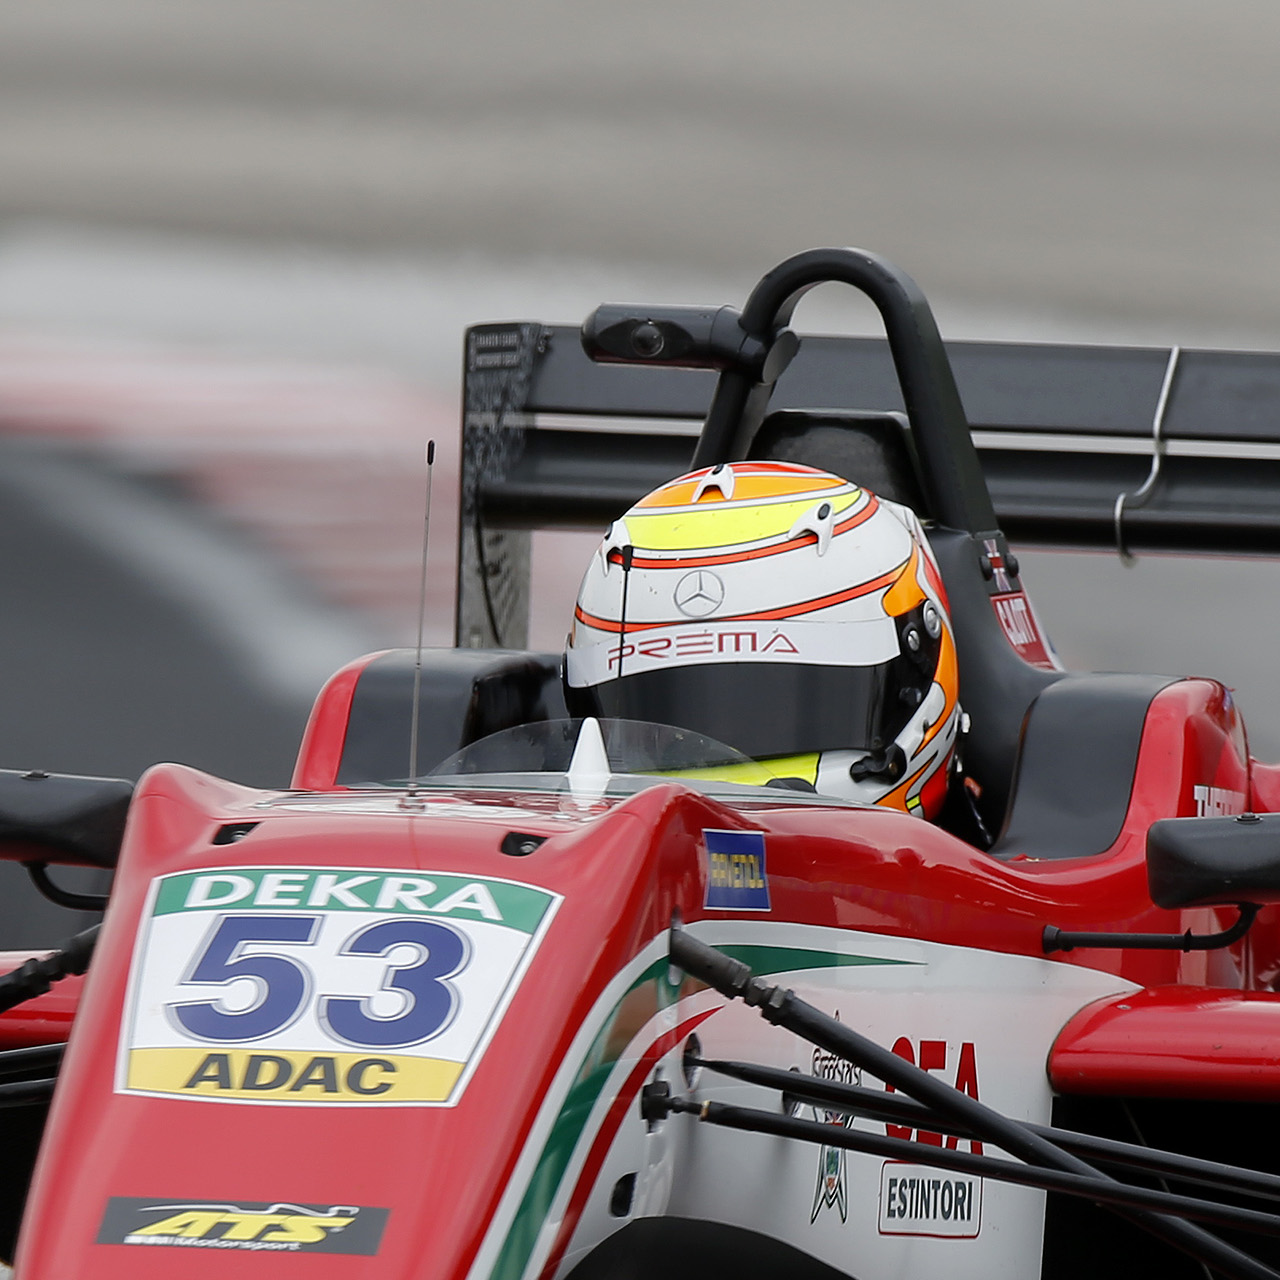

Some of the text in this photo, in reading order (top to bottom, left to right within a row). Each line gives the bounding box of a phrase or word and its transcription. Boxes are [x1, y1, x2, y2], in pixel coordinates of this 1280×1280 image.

[608, 631, 799, 671] PREMA
[183, 872, 504, 922] DEKRA
[164, 913, 474, 1049] 53
[183, 1052, 399, 1096] ADAC
[886, 1178, 974, 1222] ESTINTORI
[128, 1210, 357, 1244] ATS
